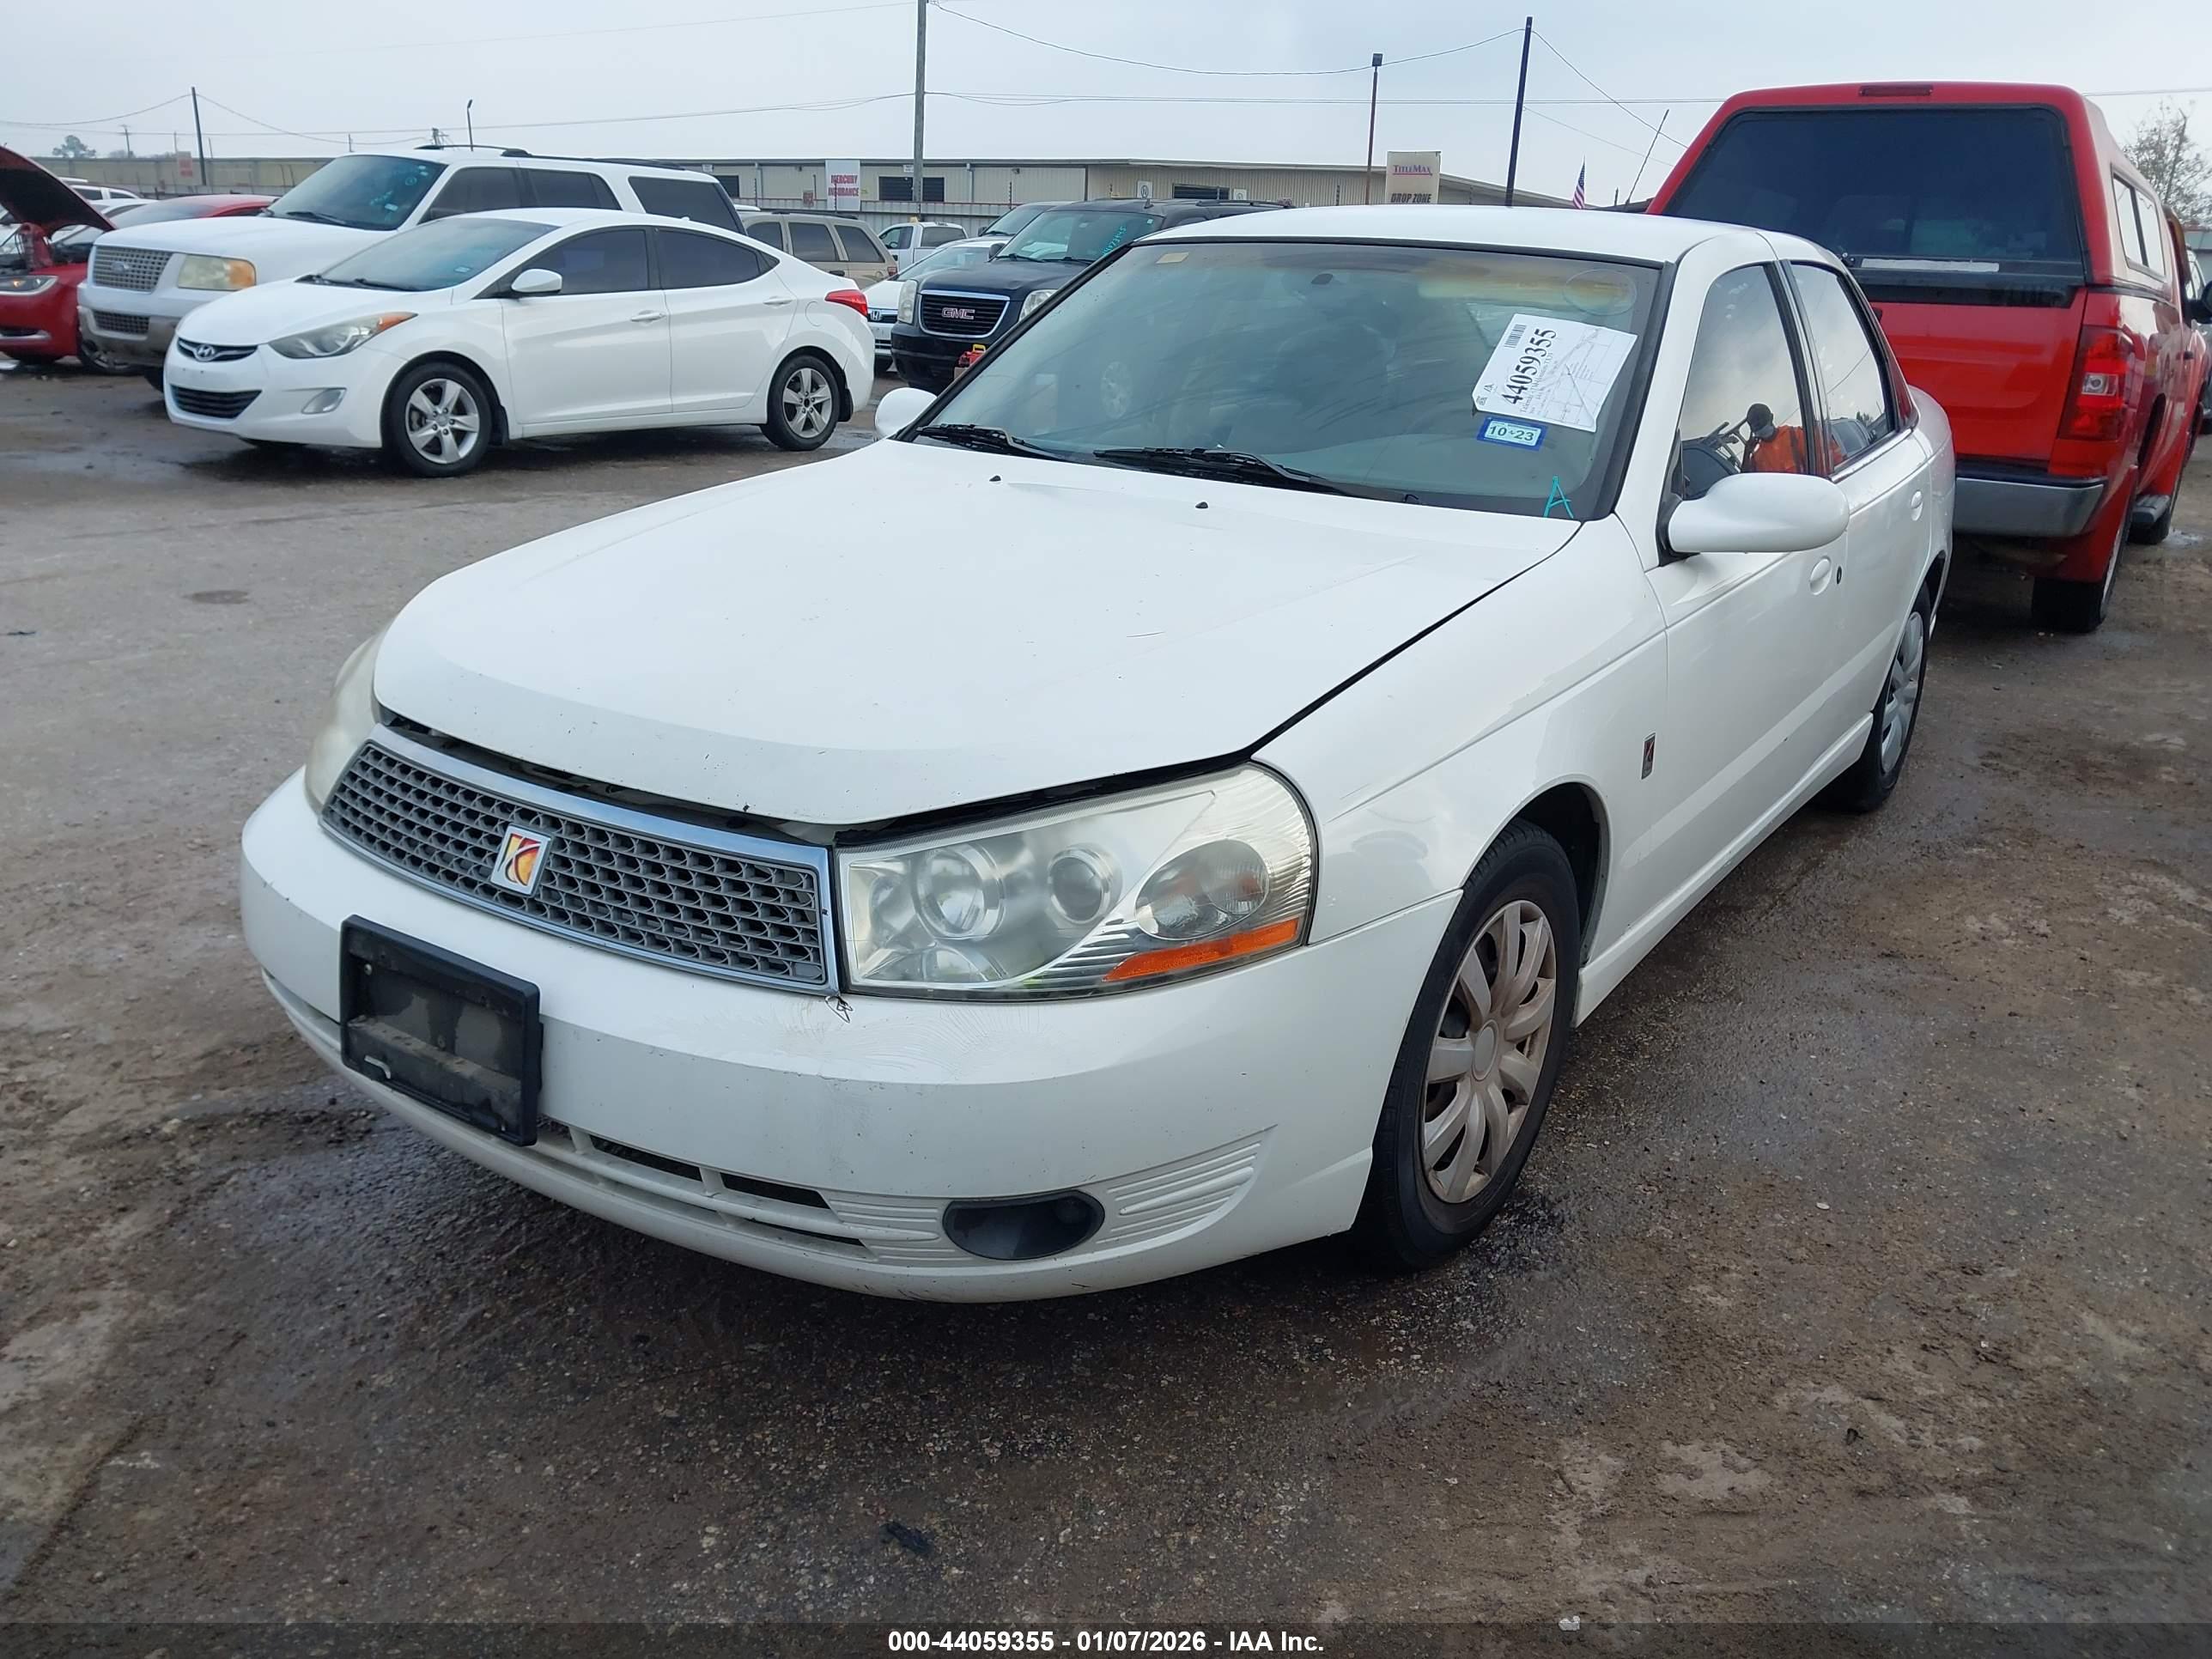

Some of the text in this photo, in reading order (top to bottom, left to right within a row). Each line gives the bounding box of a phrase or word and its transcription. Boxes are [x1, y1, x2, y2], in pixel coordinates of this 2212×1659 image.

[830, 174, 858, 184] MERCURY
[828, 187, 860, 197] INURANCE
[1390, 192, 1431, 204] DROP ZONE
[941, 307, 975, 320] GMC
[1501, 328, 1557, 404] 44059355
[1490, 426, 1507, 436] 10
[1514, 430, 1534, 441] 23
[1543, 476, 1574, 519] A
